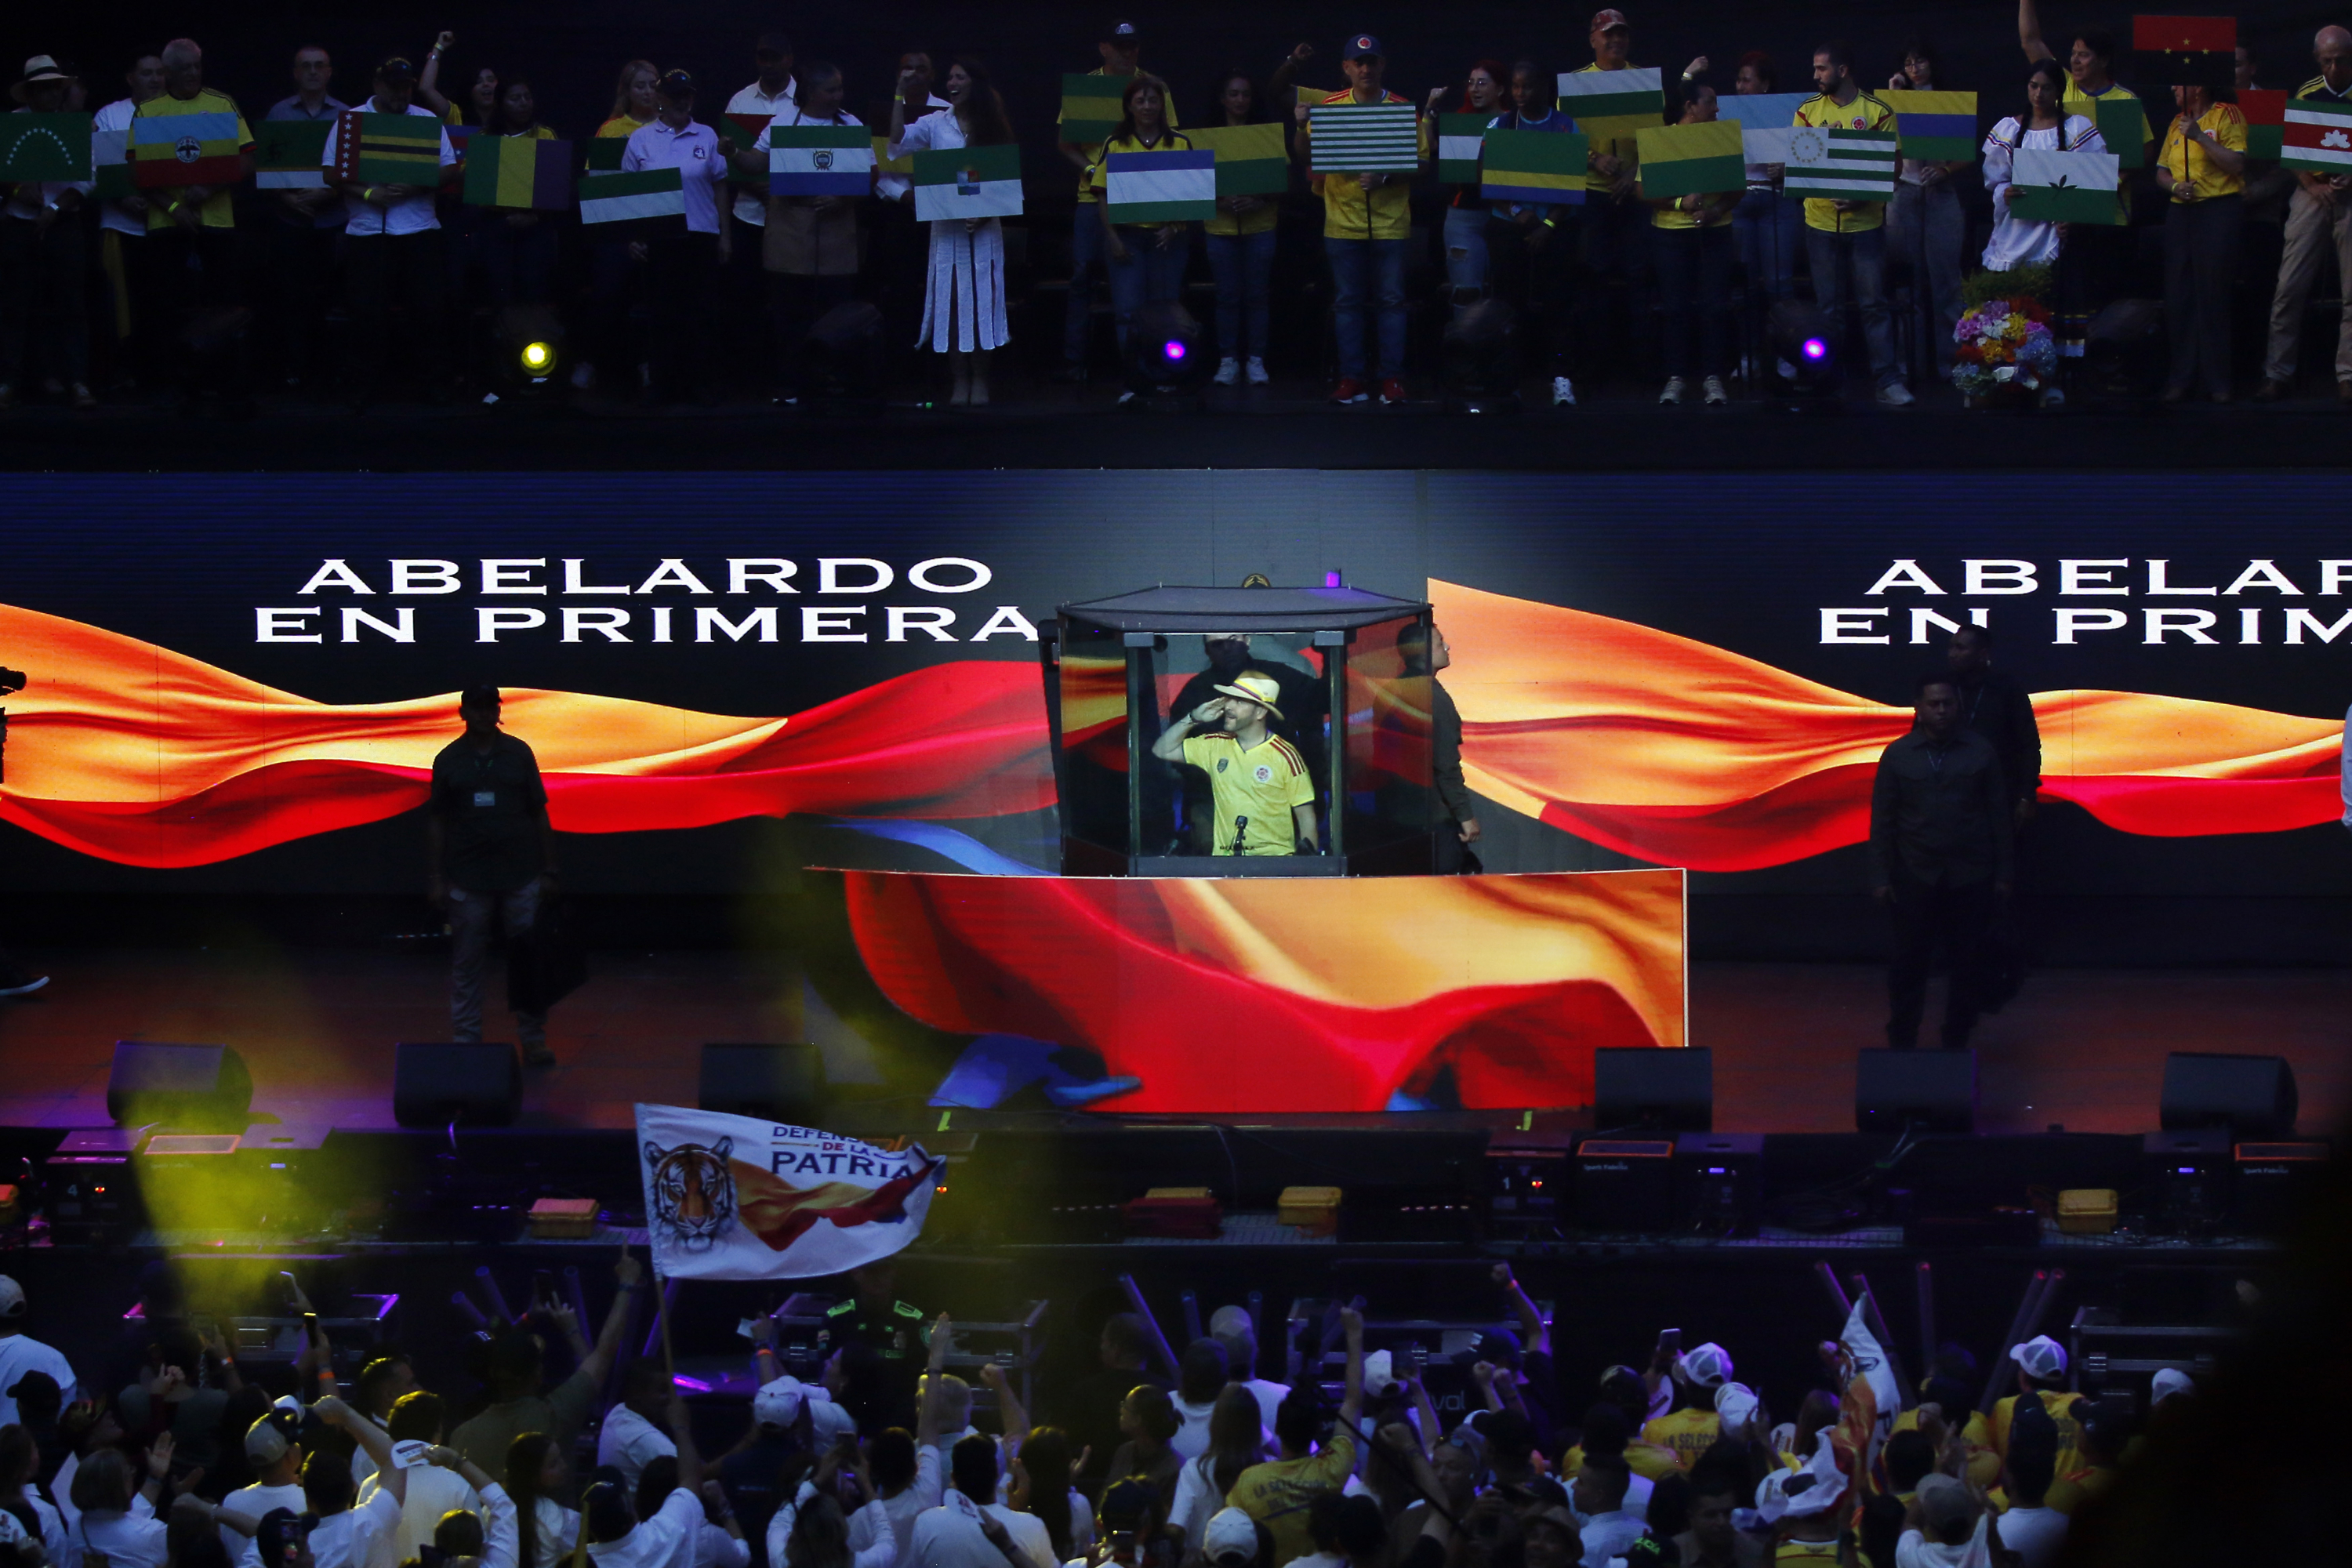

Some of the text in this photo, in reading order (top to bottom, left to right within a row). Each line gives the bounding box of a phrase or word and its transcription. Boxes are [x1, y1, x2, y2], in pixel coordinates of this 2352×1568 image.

[297, 557, 993, 596] ABELARDO
[256, 605, 1039, 644] EN PRIMERA
[1819, 607, 2352, 644] EN PRIM
[771, 1151, 914, 1179] PATRIA
[822, 1142, 870, 1156] DE LA
[67, 1184, 78, 1196] 4
